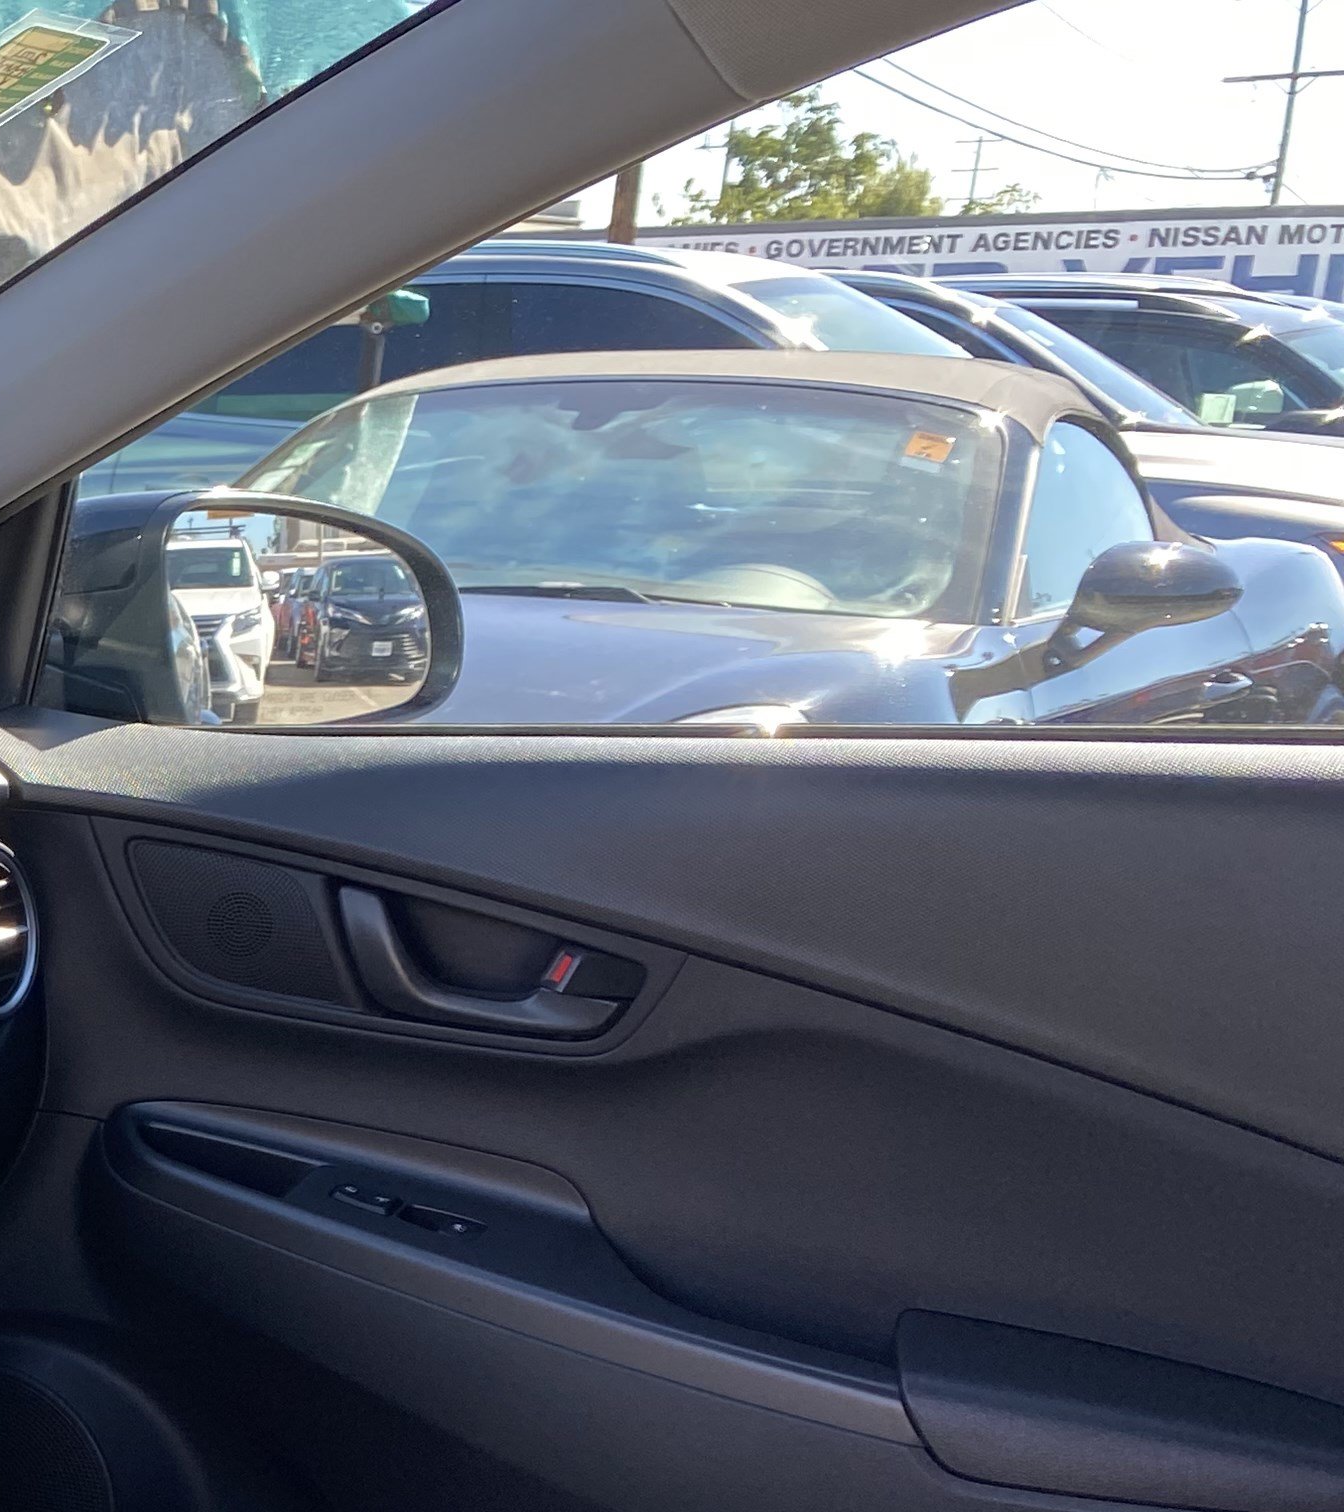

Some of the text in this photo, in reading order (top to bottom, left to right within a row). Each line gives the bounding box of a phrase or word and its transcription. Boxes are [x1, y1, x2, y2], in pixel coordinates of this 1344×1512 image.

[765, 233, 963, 260] GOVERNMENT
[968, 229, 1121, 252] AGENCIES
[1147, 224, 1268, 248] NISSAN
